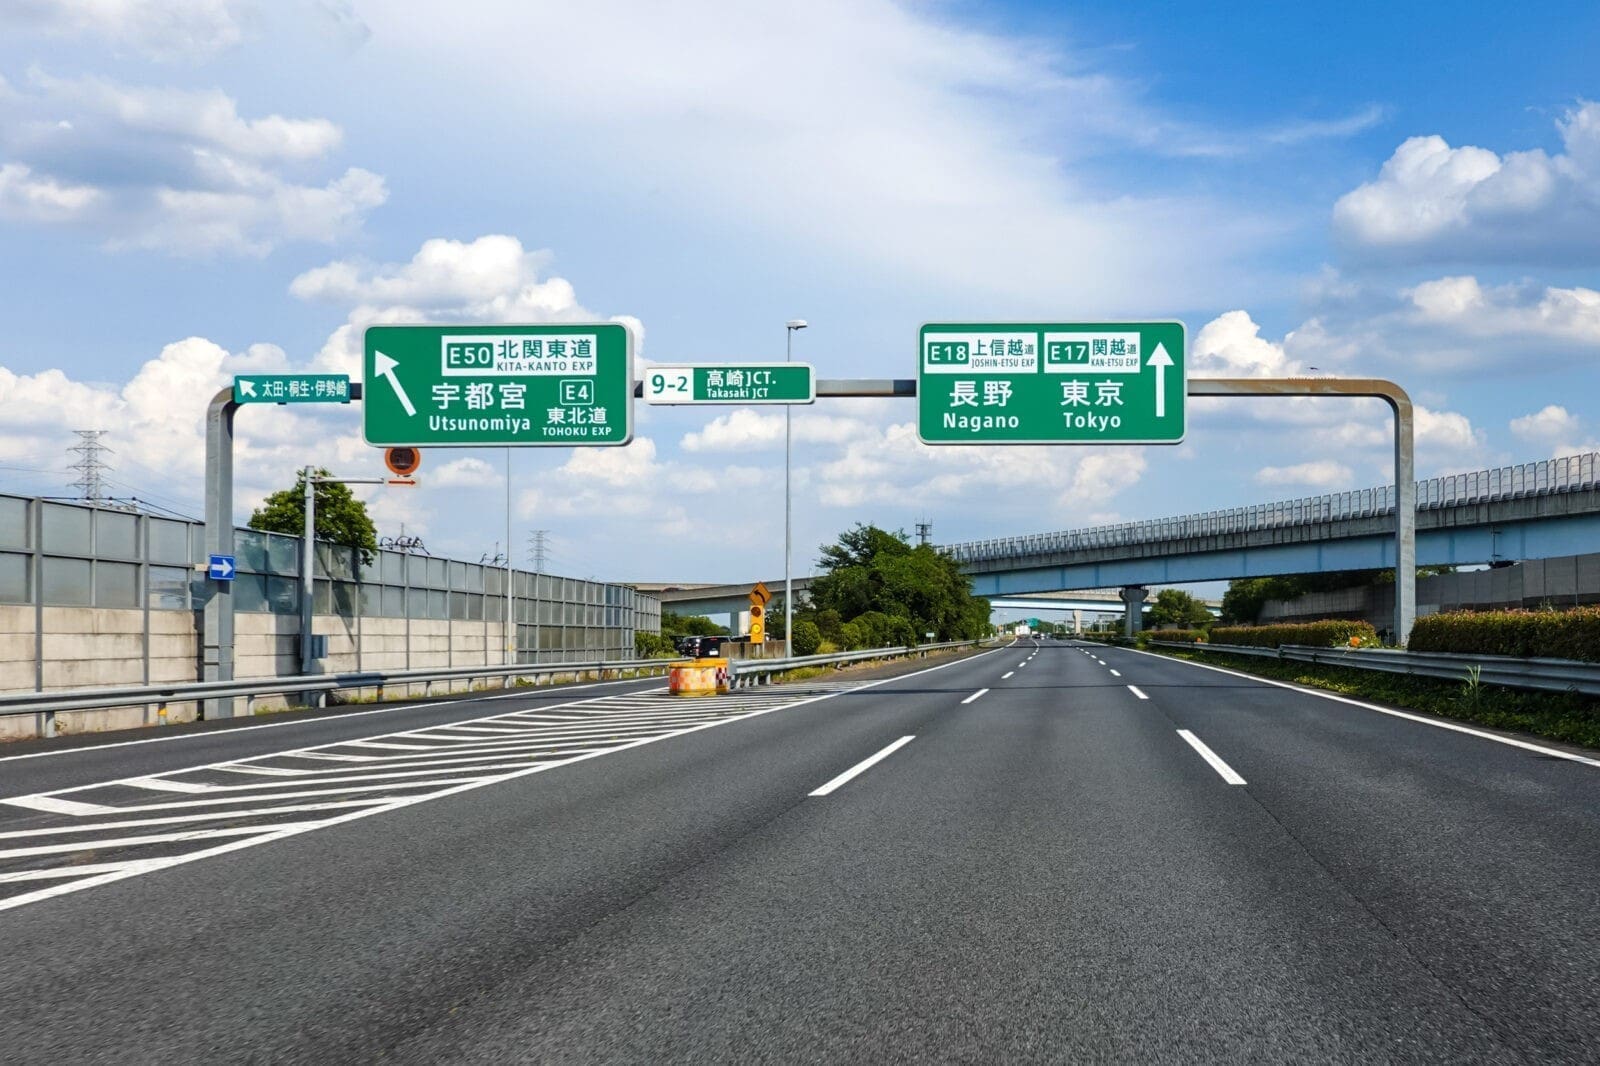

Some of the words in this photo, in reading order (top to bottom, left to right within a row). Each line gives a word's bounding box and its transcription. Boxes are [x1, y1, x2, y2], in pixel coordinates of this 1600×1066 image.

[450, 346, 492, 365] E50
[497, 339, 593, 360] 北関東道
[930, 345, 967, 361] E18
[971, 339, 1034, 357] 上信越道
[1050, 345, 1087, 361] E17
[1092, 339, 1137, 356] 関越道
[496, 361, 567, 372] KITA-KANTO
[572, 361, 593, 371] EXP
[971, 358, 1019, 369] JOSHIN-ETSU
[1021, 358, 1035, 367] EXP
[1090, 358, 1124, 367] KAN-ETSU
[1125, 358, 1138, 367] EXP
[652, 374, 688, 394] 9-2
[706, 370, 777, 388] 高崎JCT.
[431, 382, 527, 410] 宇都宮
[564, 384, 589, 400] E4
[706, 387, 749, 398] Takasaki
[752, 388, 769, 399] JCT
[949, 380, 1013, 407] 長野
[1060, 379, 1124, 406] 東京
[429, 414, 531, 434] Utsunomiya
[546, 406, 608, 425] 東北道
[943, 412, 1019, 432] Nagano
[1063, 411, 1121, 432] Tokyo
[542, 426, 588, 436] TOHOKU
[592, 426, 612, 436] EXP
